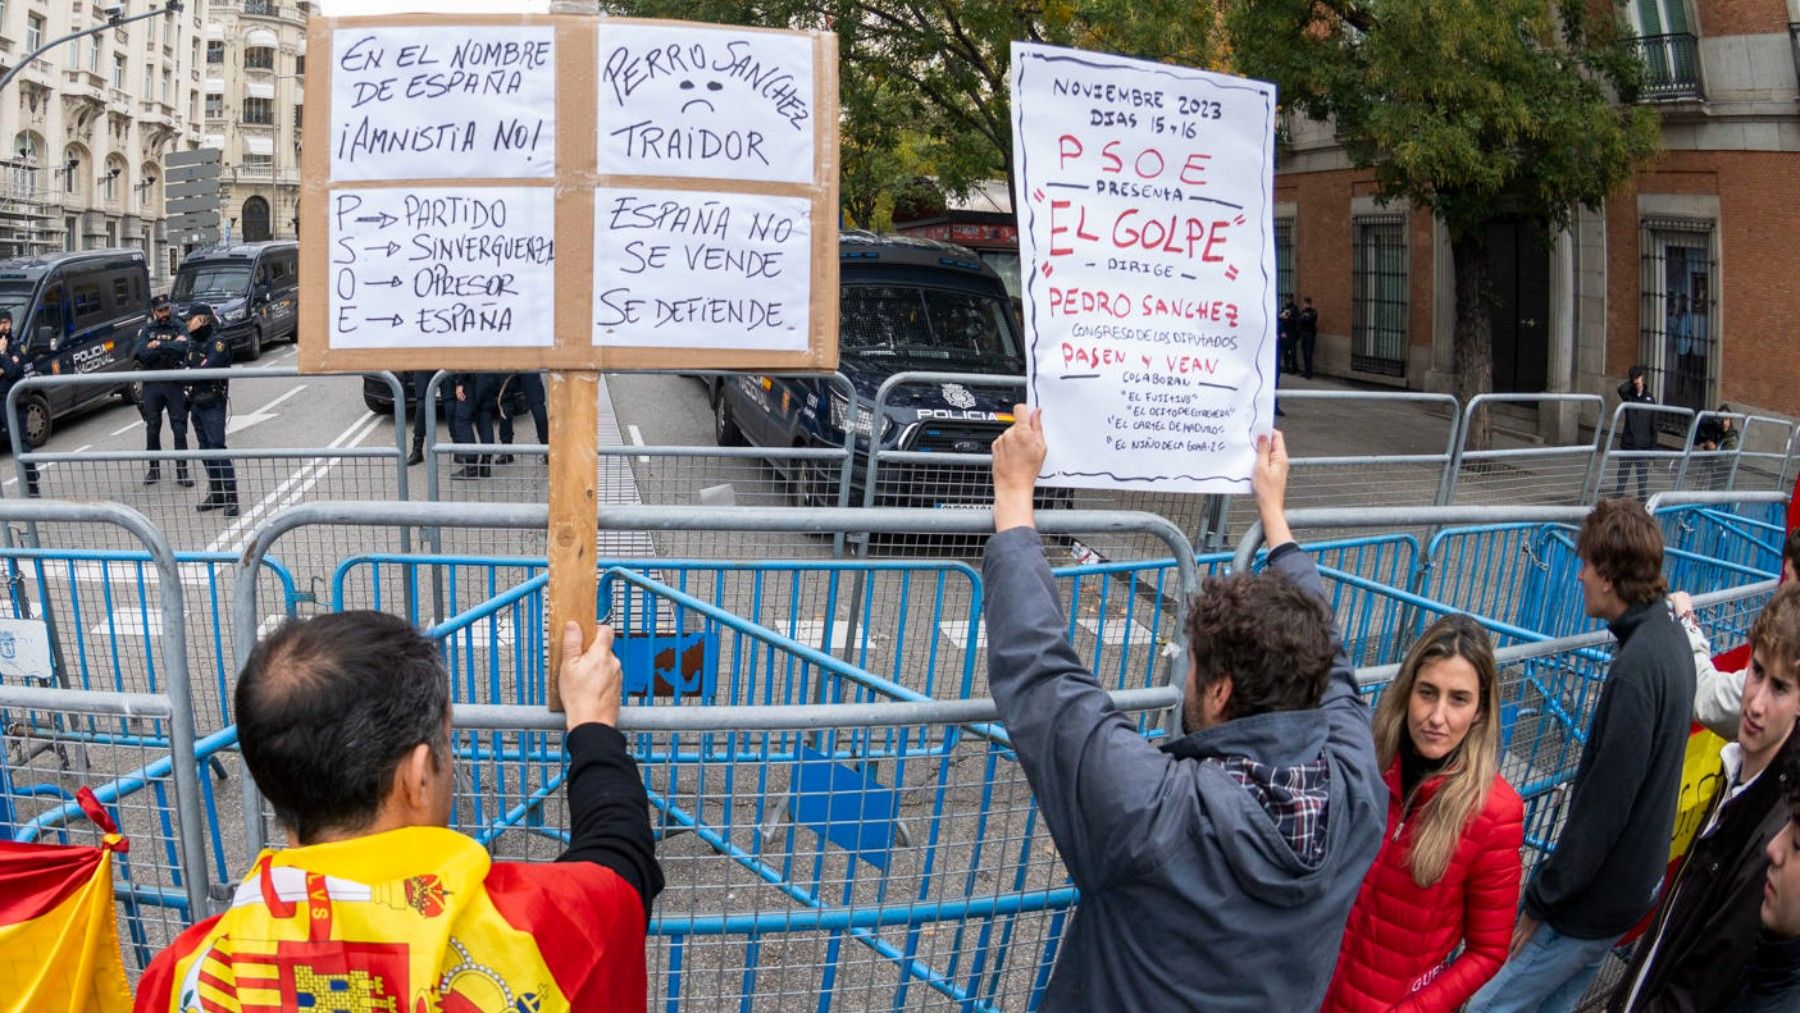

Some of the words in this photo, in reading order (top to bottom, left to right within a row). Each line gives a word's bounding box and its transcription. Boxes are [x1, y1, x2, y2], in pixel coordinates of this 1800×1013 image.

[341, 36, 384, 71] EN
[397, 44, 439, 67] EL
[450, 39, 552, 70] NOMBRE
[351, 78, 398, 108] DE
[406, 70, 522, 98] ESPAÑA
[603, 44, 706, 106] PERRO
[712, 40, 809, 131] SANCHEZ
[1052, 78, 1164, 109] NOVIEMBRE
[1179, 96, 1223, 120] 2023
[493, 118, 543, 162] NO!
[610, 119, 770, 166] TRAIDOR
[1090, 109, 1138, 129] DIAS
[1151, 116, 1165, 133] 15
[1181, 121, 1197, 139] 16
[336, 195, 362, 231] P
[404, 194, 507, 230] PARTIDO
[610, 197, 730, 240] ESPAÑA
[749, 213, 793, 243] NO
[333, 236, 356, 264] S
[620, 241, 671, 274] SE
[685, 243, 784, 278] VENDE
[1108, 258, 1173, 278] DIRIGE
[337, 267, 356, 301] O
[413, 263, 519, 299] OPRESOR
[338, 305, 358, 333] E
[415, 302, 513, 334] ESPAÑA
[597, 288, 646, 327] SE
[1049, 287, 1131, 319] PEDRO
[1142, 294, 1239, 328] SANCHEZ
[1061, 342, 1126, 370] PASEN
[1166, 355, 1220, 375] VEAN
[1123, 371, 1191, 387] COLABORAN
[917, 409, 998, 421] POLICIA
